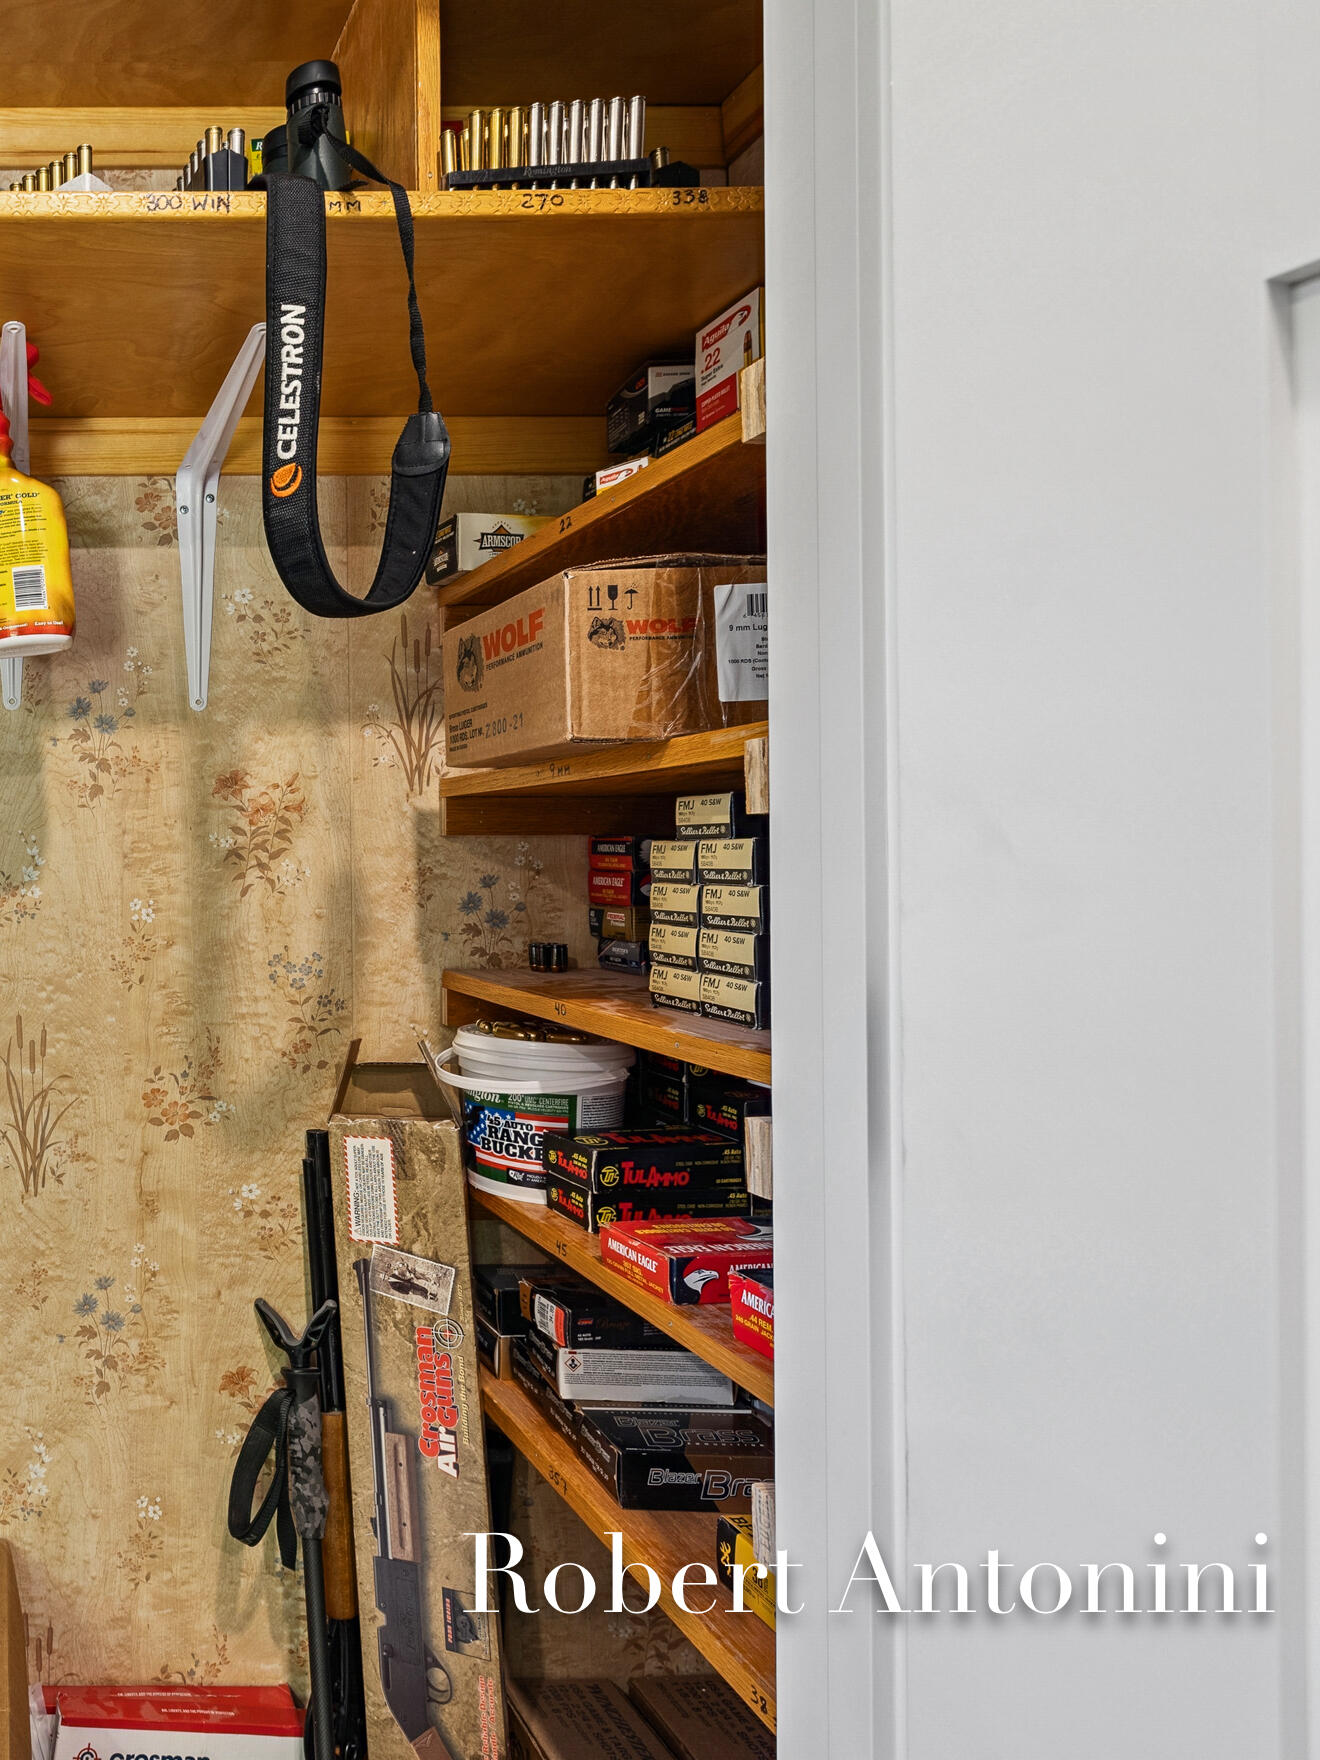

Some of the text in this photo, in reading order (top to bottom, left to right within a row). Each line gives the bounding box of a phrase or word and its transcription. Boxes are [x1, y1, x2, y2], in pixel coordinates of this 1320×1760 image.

[522, 166, 573, 177] Remington
[146, 194, 231, 213] 300 WIN
[521, 193, 564, 210] 270
[672, 189, 709, 205] 338
[703, 322, 731, 348] Aguila
[700, 347, 721, 374] .22
[277, 304, 306, 460] CELESTRON
[559, 516, 573, 534] 22
[482, 607, 545, 661] WOLF
[625, 617, 702, 634] WOLF
[728, 624, 734, 632] 9
[752, 624, 768, 633] Lug
[485, 641, 544, 671] PERFORMANCE AMMUNITION
[678, 799, 695, 811] FMJ
[708, 798, 722, 806] S&W
[652, 845, 666, 854] FMJ
[700, 843, 717, 854] FMJ
[730, 843, 744, 851] S&W
[652, 886, 668, 896] FMJ
[679, 887, 691, 895] S&W
[705, 888, 722, 899] FMJ
[736, 890, 750, 898] S&W
[651, 927, 666, 938] FMJ
[677, 930, 690, 938] S&W
[701, 932, 746, 945] FMJ 40 S&W
[652, 968, 693, 982] FMJ 40 S&W
[702, 976, 748, 992] FMJ 40 S&W
[554, 1001, 567, 1016] 40
[539, 1097, 569, 1106] CENTERFIRE
[487, 1113, 534, 1132] 45 AUTO
[487, 1124, 544, 1147] RANG
[480, 1136, 544, 1161] BUCKE
[556, 1239, 568, 1257] 45
[607, 1237, 659, 1274] AMERICAN EAGLE
[457, 1355, 465, 1382] Bond
[415, 1325, 440, 1458] Crosman
[434, 1352, 460, 1480] Air Guns
[461, 1404, 470, 1446] Building
[639, 1425, 761, 1448] Brass
[547, 1464, 568, 1496] 357
[647, 1467, 703, 1486] Blazer
[700, 1469, 754, 1501] Bra
[750, 1684, 768, 1715] 38
